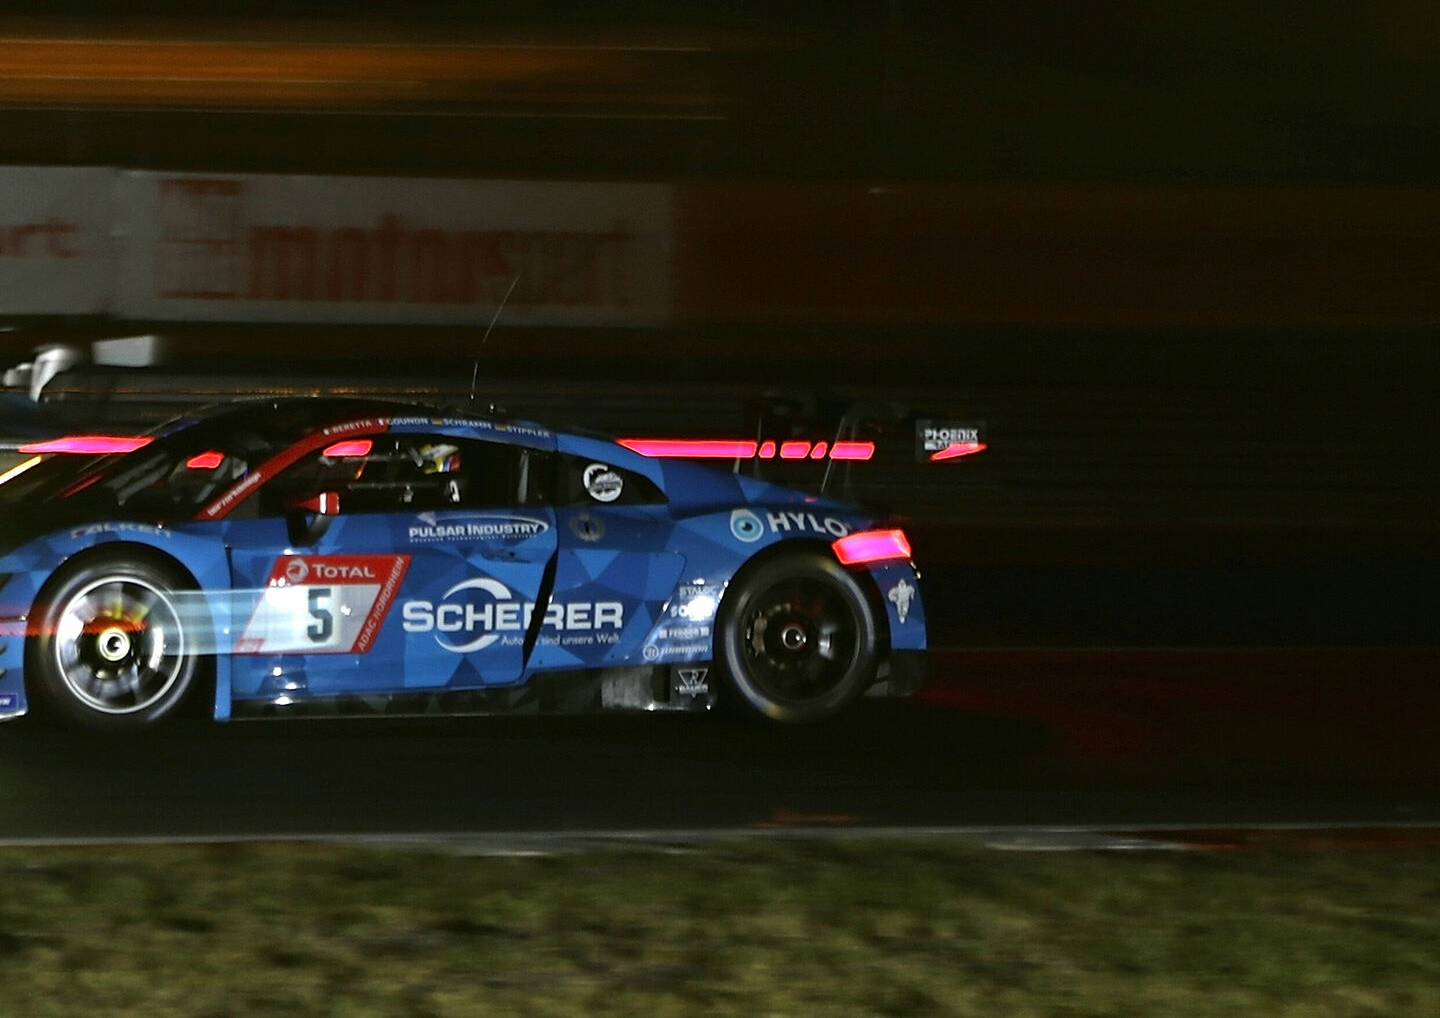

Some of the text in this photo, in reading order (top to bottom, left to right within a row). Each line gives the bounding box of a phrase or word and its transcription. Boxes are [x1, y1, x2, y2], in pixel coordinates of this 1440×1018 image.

[924, 428, 979, 440] PHOENIX
[409, 523, 539, 538] PULSAR INDUSTRY
[766, 512, 848, 537] HYLO
[312, 563, 376, 579] TOTAL
[307, 587, 334, 643] 5
[402, 600, 624, 633] SCHERER
[359, 621, 379, 652] ADAC
[541, 634, 560, 646] sind
[563, 635, 594, 646] unsere
[596, 633, 622, 644] Welt.
